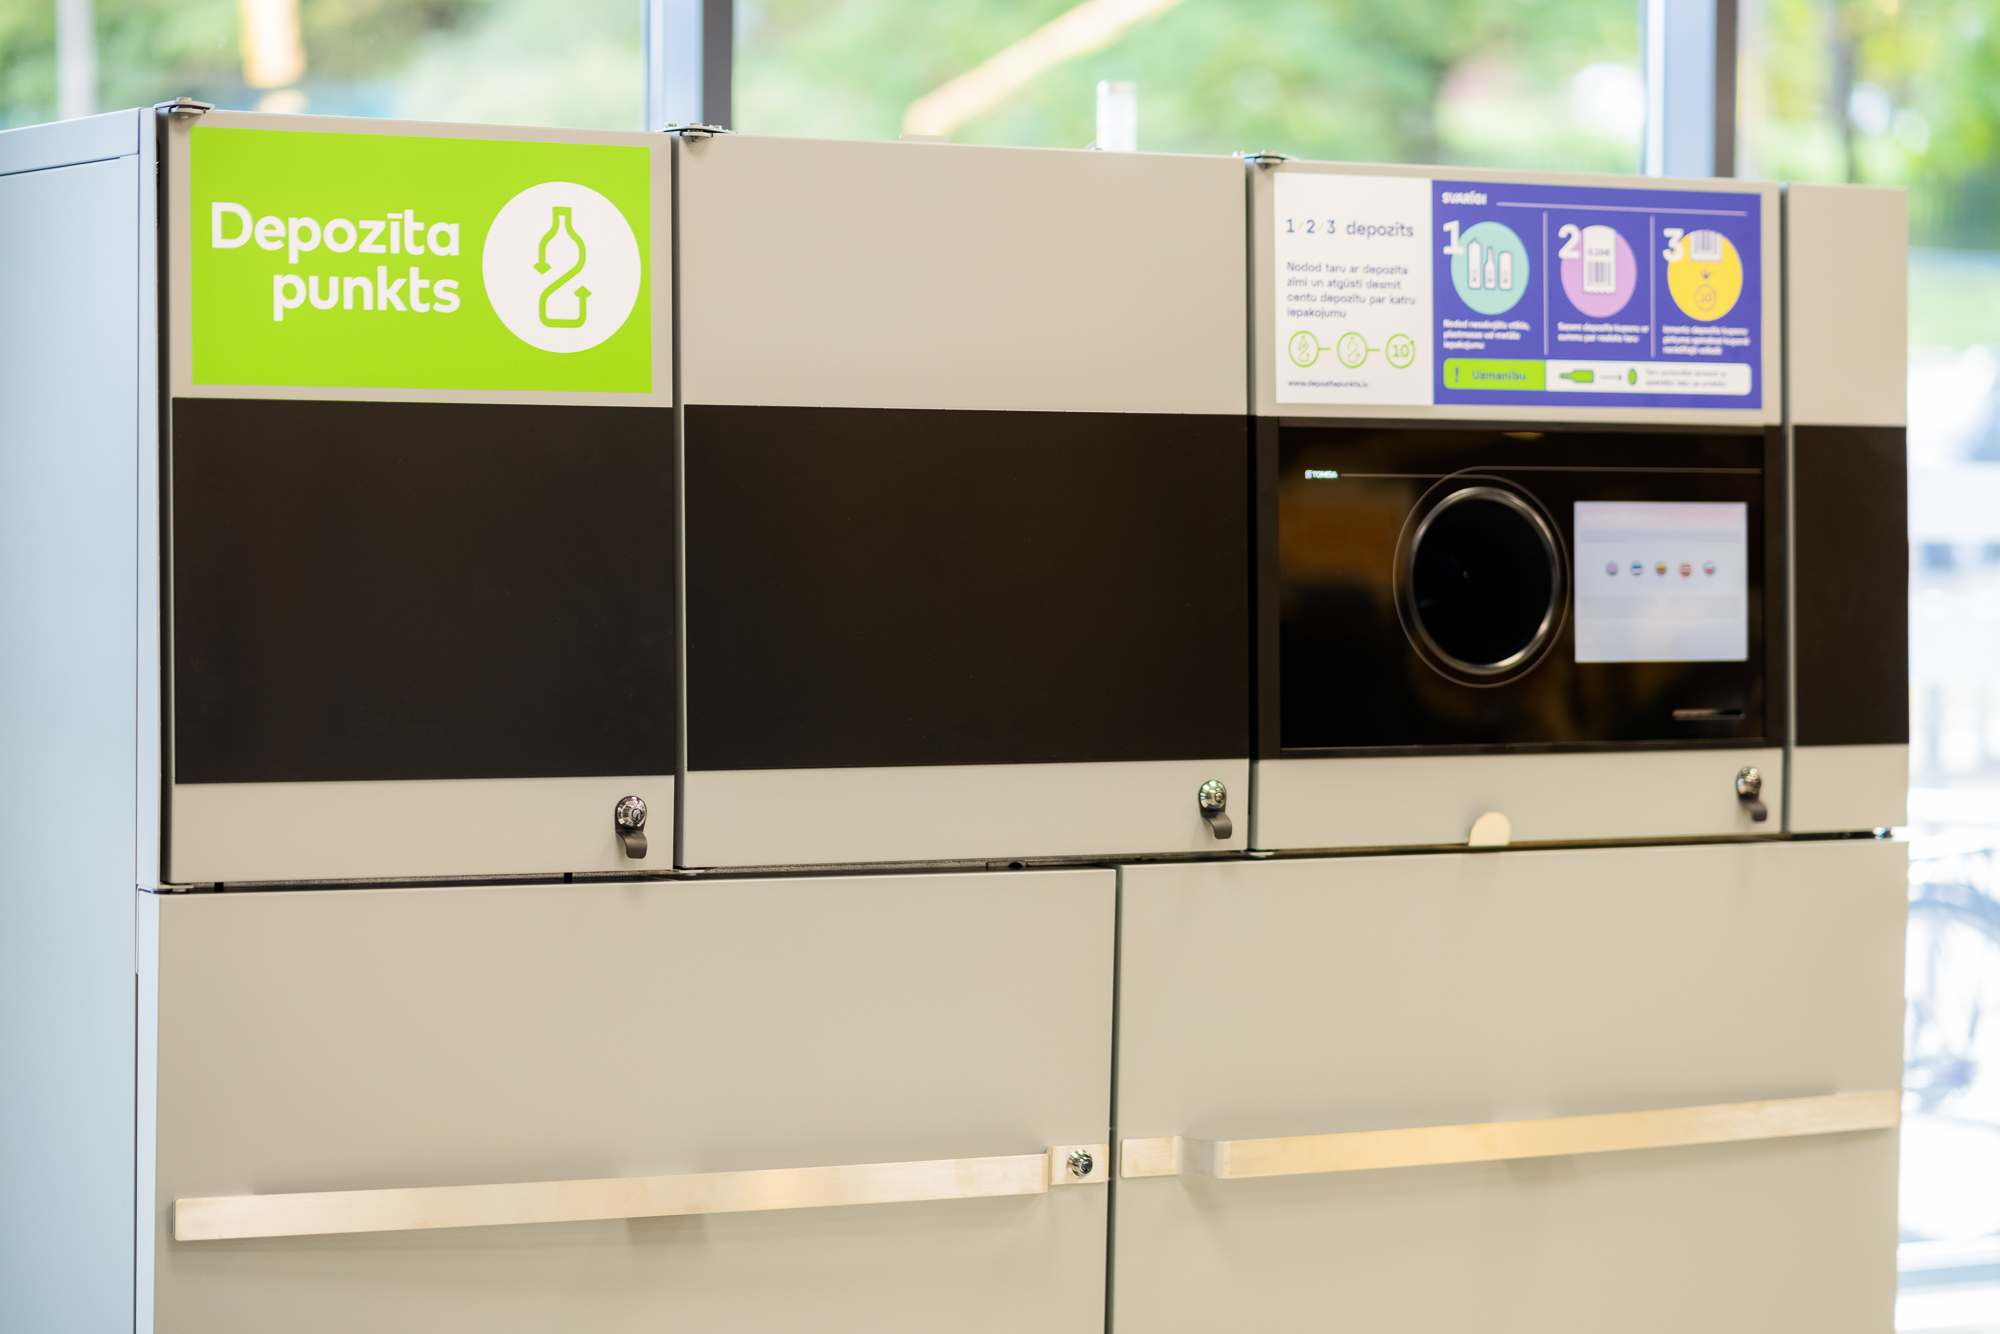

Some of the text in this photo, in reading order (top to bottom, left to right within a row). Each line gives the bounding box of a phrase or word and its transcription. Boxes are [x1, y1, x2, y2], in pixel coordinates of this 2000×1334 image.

[211, 201, 460, 264] Depozīta
[1442, 220, 1465, 255] 1
[1558, 223, 1581, 259] 2
[1662, 227, 1685, 263] 3
[1287, 262, 1322, 273] Nodod
[1325, 264, 1346, 273] taru
[1349, 265, 1359, 273] ar
[273, 265, 461, 322] punkts
[1311, 279, 1324, 288] un
[1366, 279, 1401, 290] desmit
[1287, 293, 1317, 303] centu
[1369, 296, 1386, 306] par
[1389, 294, 1416, 305] katru
[1287, 306, 1347, 320] iepakojumu
[1392, 344, 1410, 357] 10
